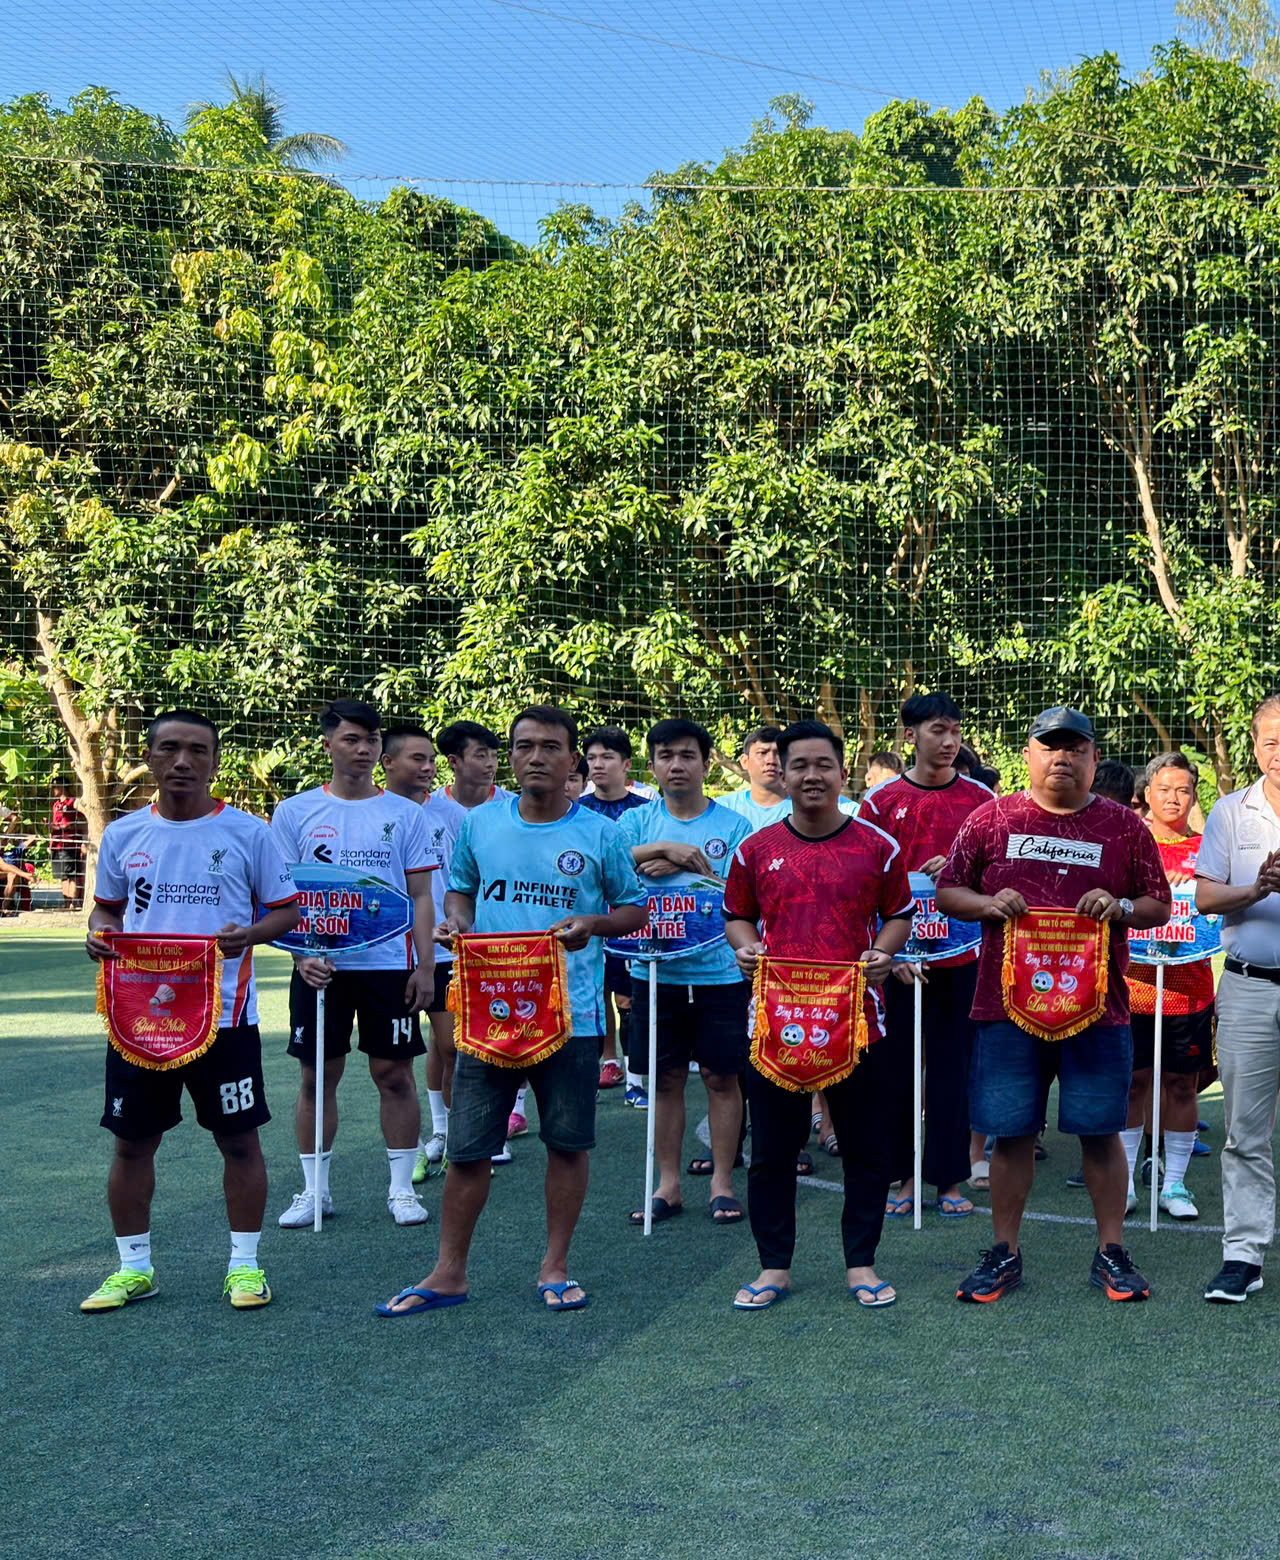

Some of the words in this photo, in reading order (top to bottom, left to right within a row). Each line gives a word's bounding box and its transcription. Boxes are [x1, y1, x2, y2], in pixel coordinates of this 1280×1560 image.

[340, 850, 391, 860] standard
[1019, 837, 1097, 860] California
[340, 858, 391, 868] chartered
[157, 882, 220, 895] standard
[514, 880, 578, 898] INFINITE
[156, 894, 221, 906] chartered
[329, 890, 362, 909] BÀN
[512, 893, 576, 910] ATHLETE
[662, 893, 696, 912] BÀN
[315, 916, 349, 935] SƠN
[656, 921, 686, 938] TRE
[916, 922, 948, 938] SƠN
[1038, 919, 1050, 928] BAN
[1051, 917, 1058, 928] TỔ
[1060, 918, 1076, 928] CHỨC
[136, 944, 151, 954] BAN
[152, 942, 162, 954] TỔ
[163, 944, 184, 956] CHỨC
[488, 944, 499, 953] BAN
[501, 942, 508, 953] TỔ
[510, 944, 527, 953] CHỨC
[792, 970, 804, 980] BAN
[805, 968, 812, 980] TỔ
[814, 970, 830, 980] CHỨC
[1026, 994, 1048, 1012] Lưu
[1051, 995, 1080, 1015] Niệm
[392, 1016, 412, 1045] 14
[485, 1022, 510, 1040] Lưu
[512, 1020, 544, 1040] Niệm
[776, 1047, 798, 1065] Lưu
[801, 1048, 833, 1068] Niệm
[220, 1076, 254, 1114] 88
